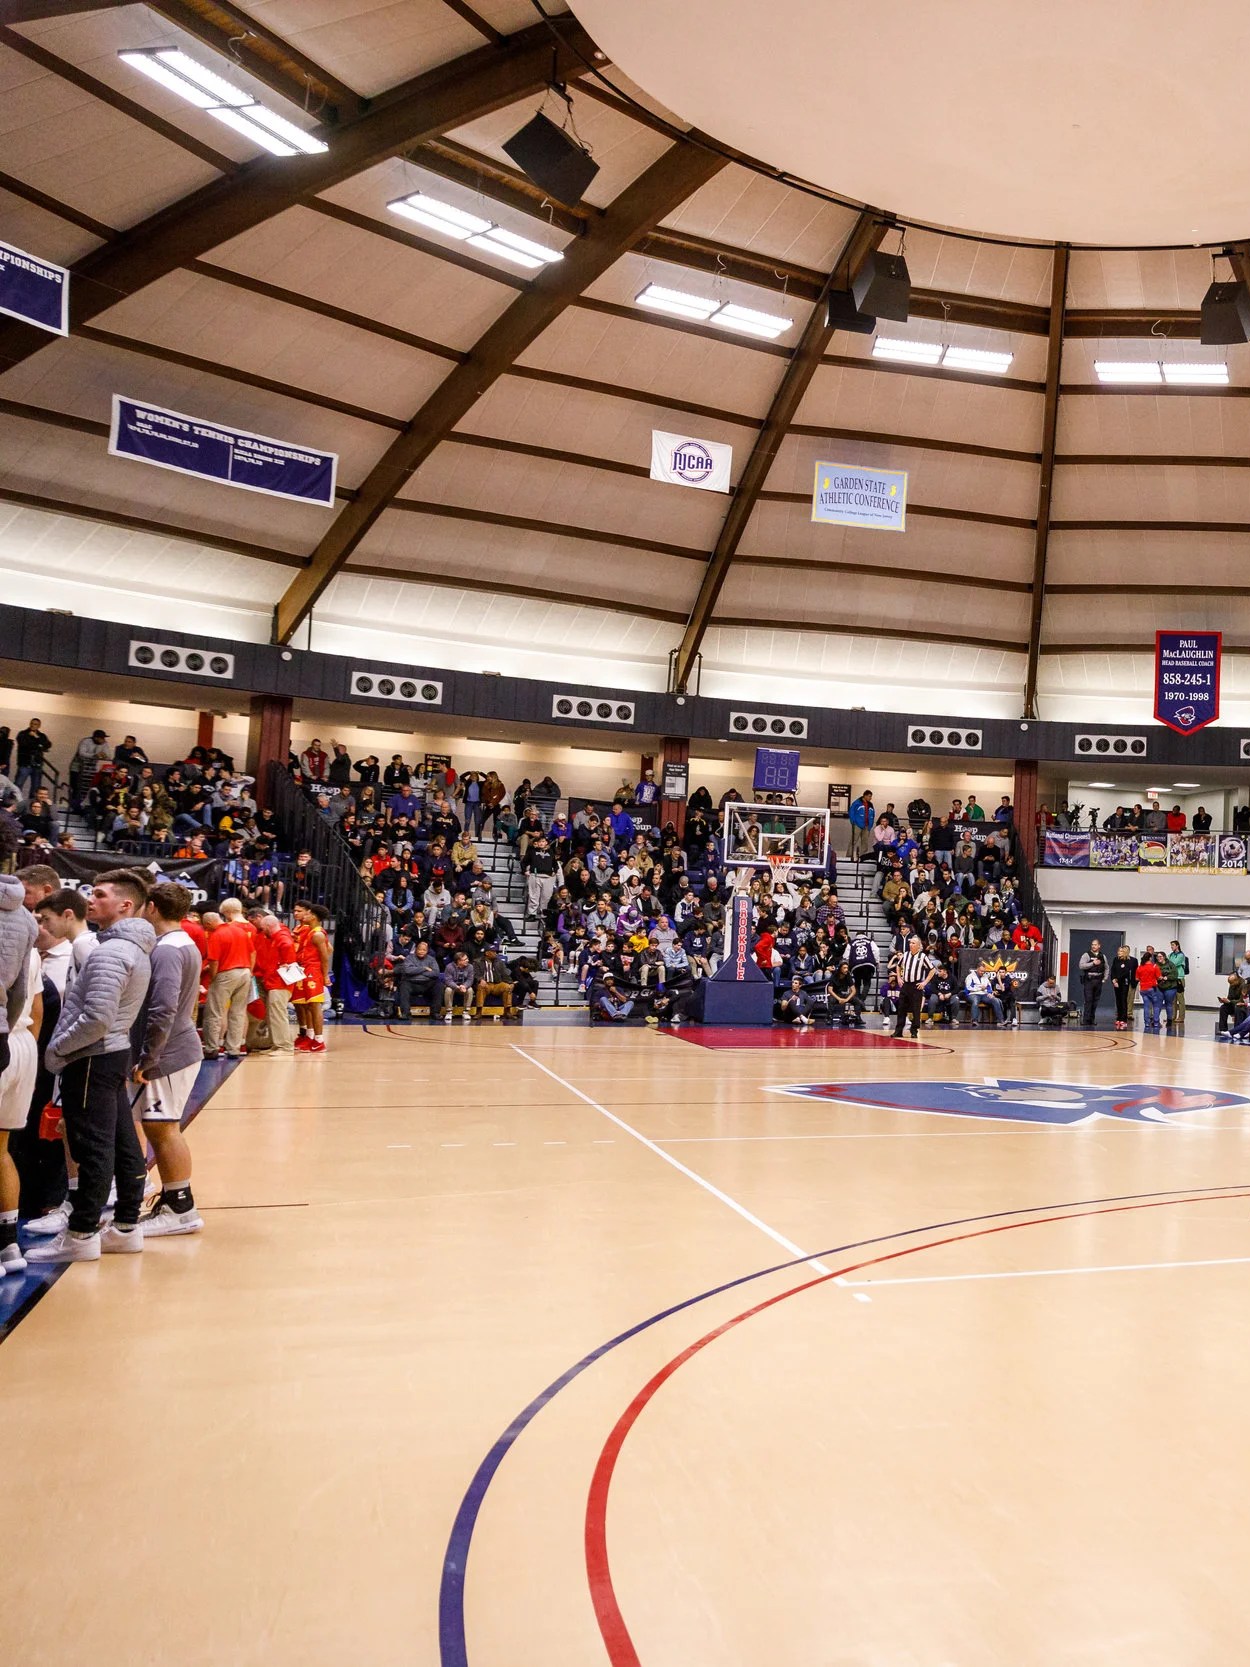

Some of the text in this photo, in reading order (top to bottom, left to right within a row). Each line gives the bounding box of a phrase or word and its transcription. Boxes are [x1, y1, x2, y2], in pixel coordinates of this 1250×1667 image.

[135, 409, 190, 432] WOMEN'S
[192, 425, 235, 445] TENNIS
[237, 439, 321, 466] CHAMPIONSHIPS
[672, 451, 713, 471] NJCAA
[833, 476, 887, 495] GARDEN STATE
[819, 491, 900, 514] ATHLETIC CONFERENCE
[1179, 639, 1198, 649] PAUL
[1163, 673, 1211, 686] 858-245-1
[310, 784, 341, 796] Hoop
[954, 824, 978, 835] Hoop
[1046, 831, 1065, 839] National
[1221, 859, 1243, 868] 2014
[737, 900, 748, 981] BROOKDALE
